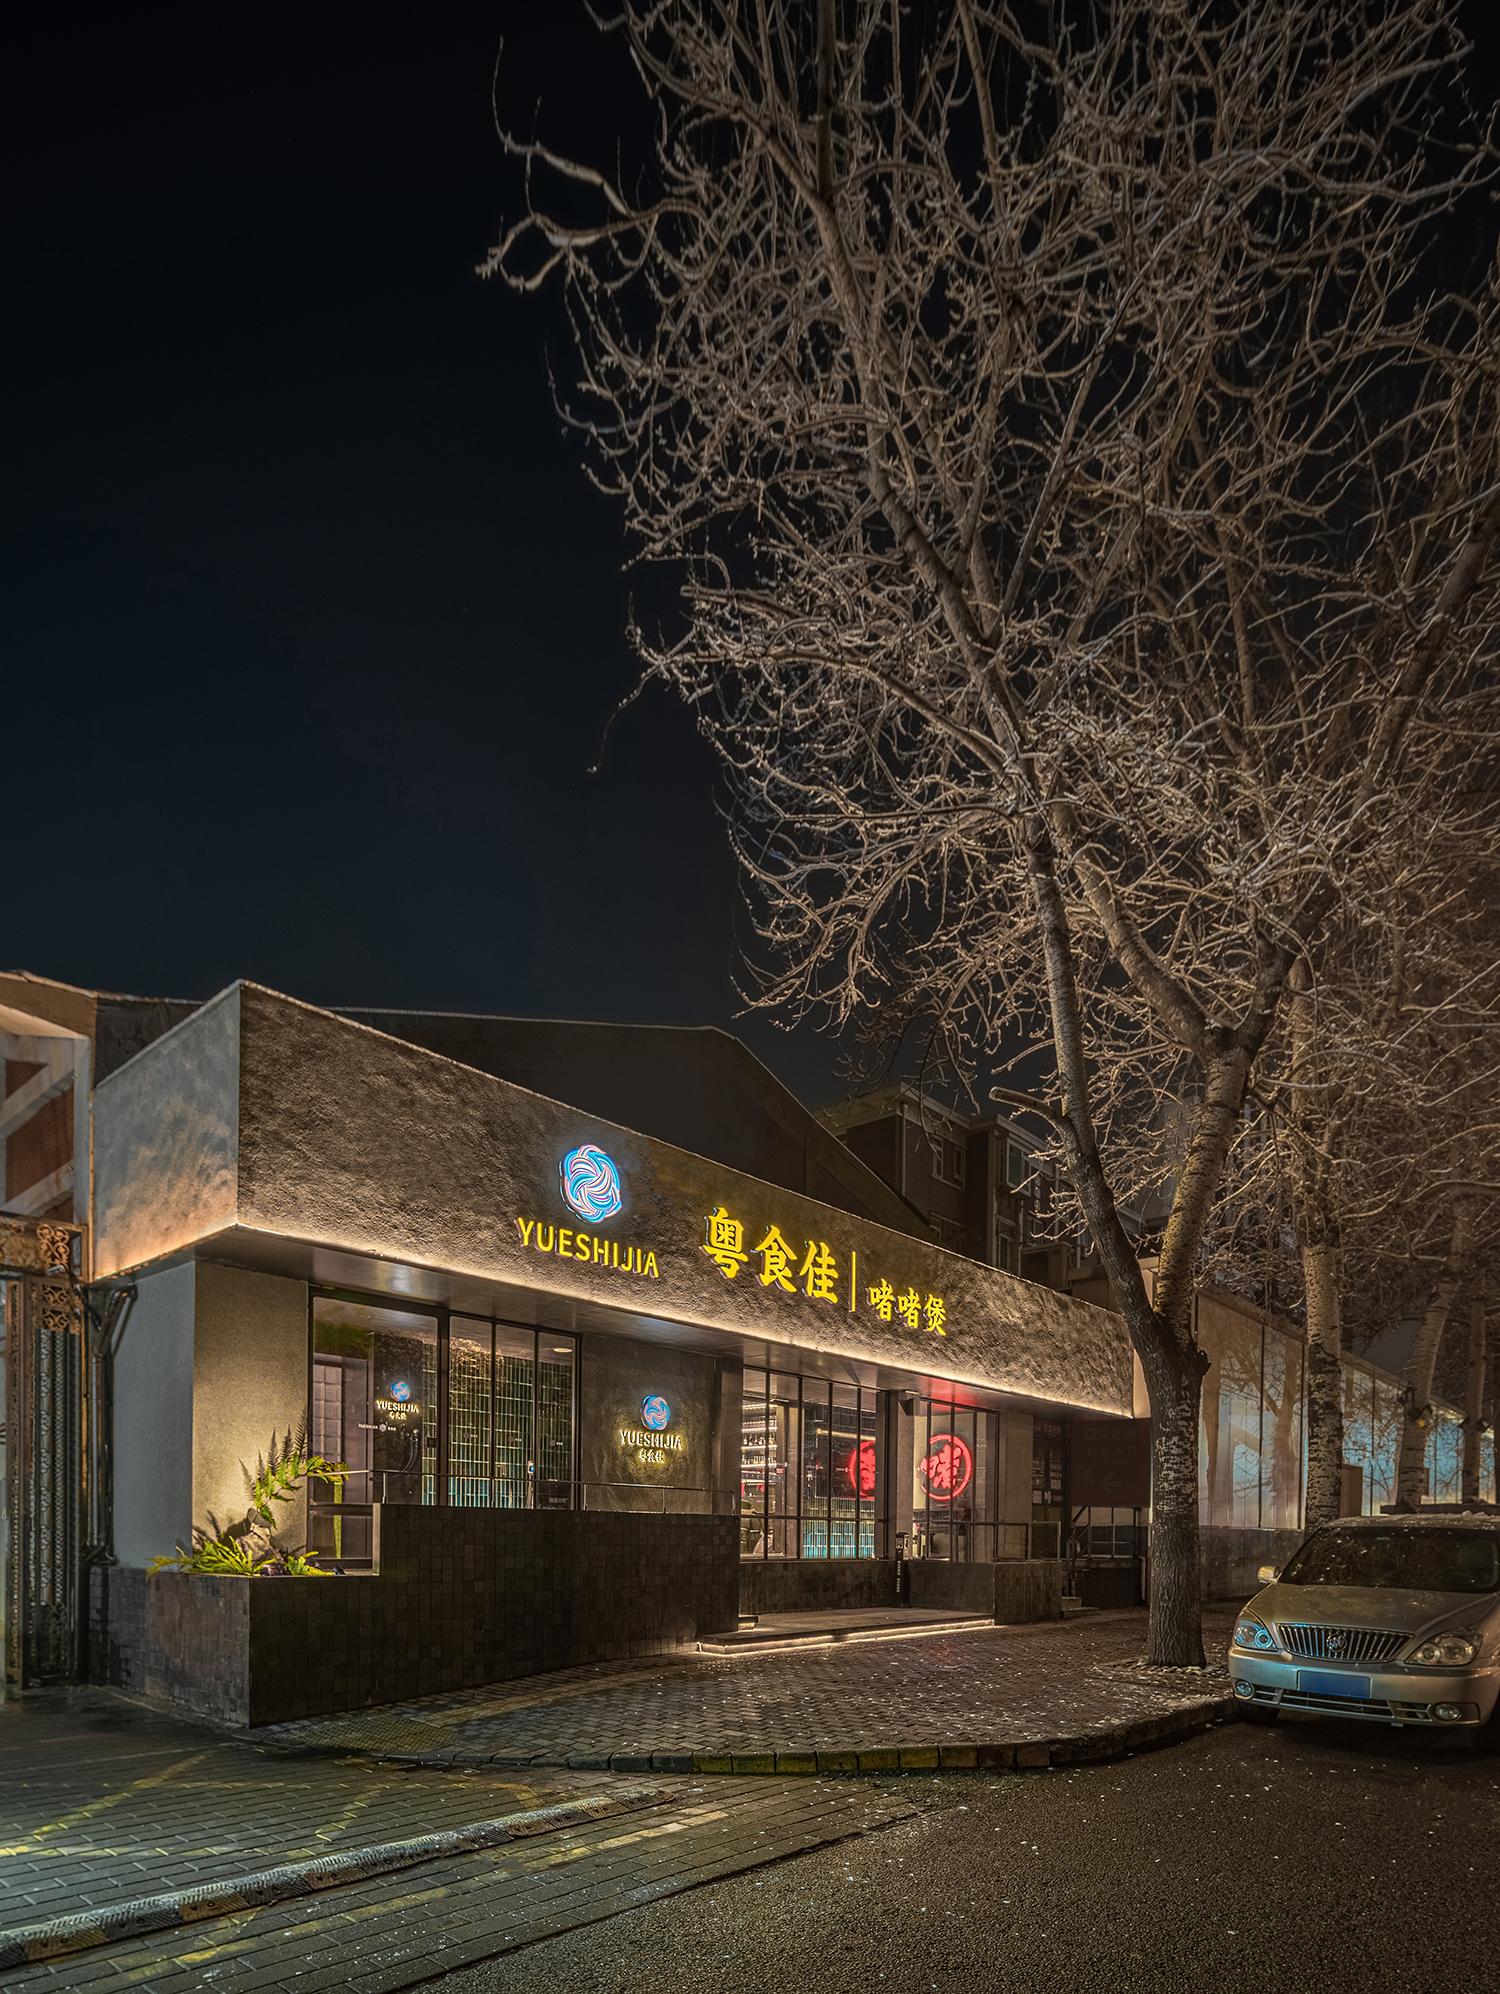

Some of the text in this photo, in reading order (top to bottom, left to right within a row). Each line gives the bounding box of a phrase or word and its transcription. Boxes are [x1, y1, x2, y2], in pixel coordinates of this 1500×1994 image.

[516, 1217, 659, 1278] YUESHIJIA
[700, 1206, 947, 1336] 粤食佳 啫啫煲
[376, 1400, 420, 1413] YUESHIJIA
[619, 1429, 683, 1451] YUESHIJIA
